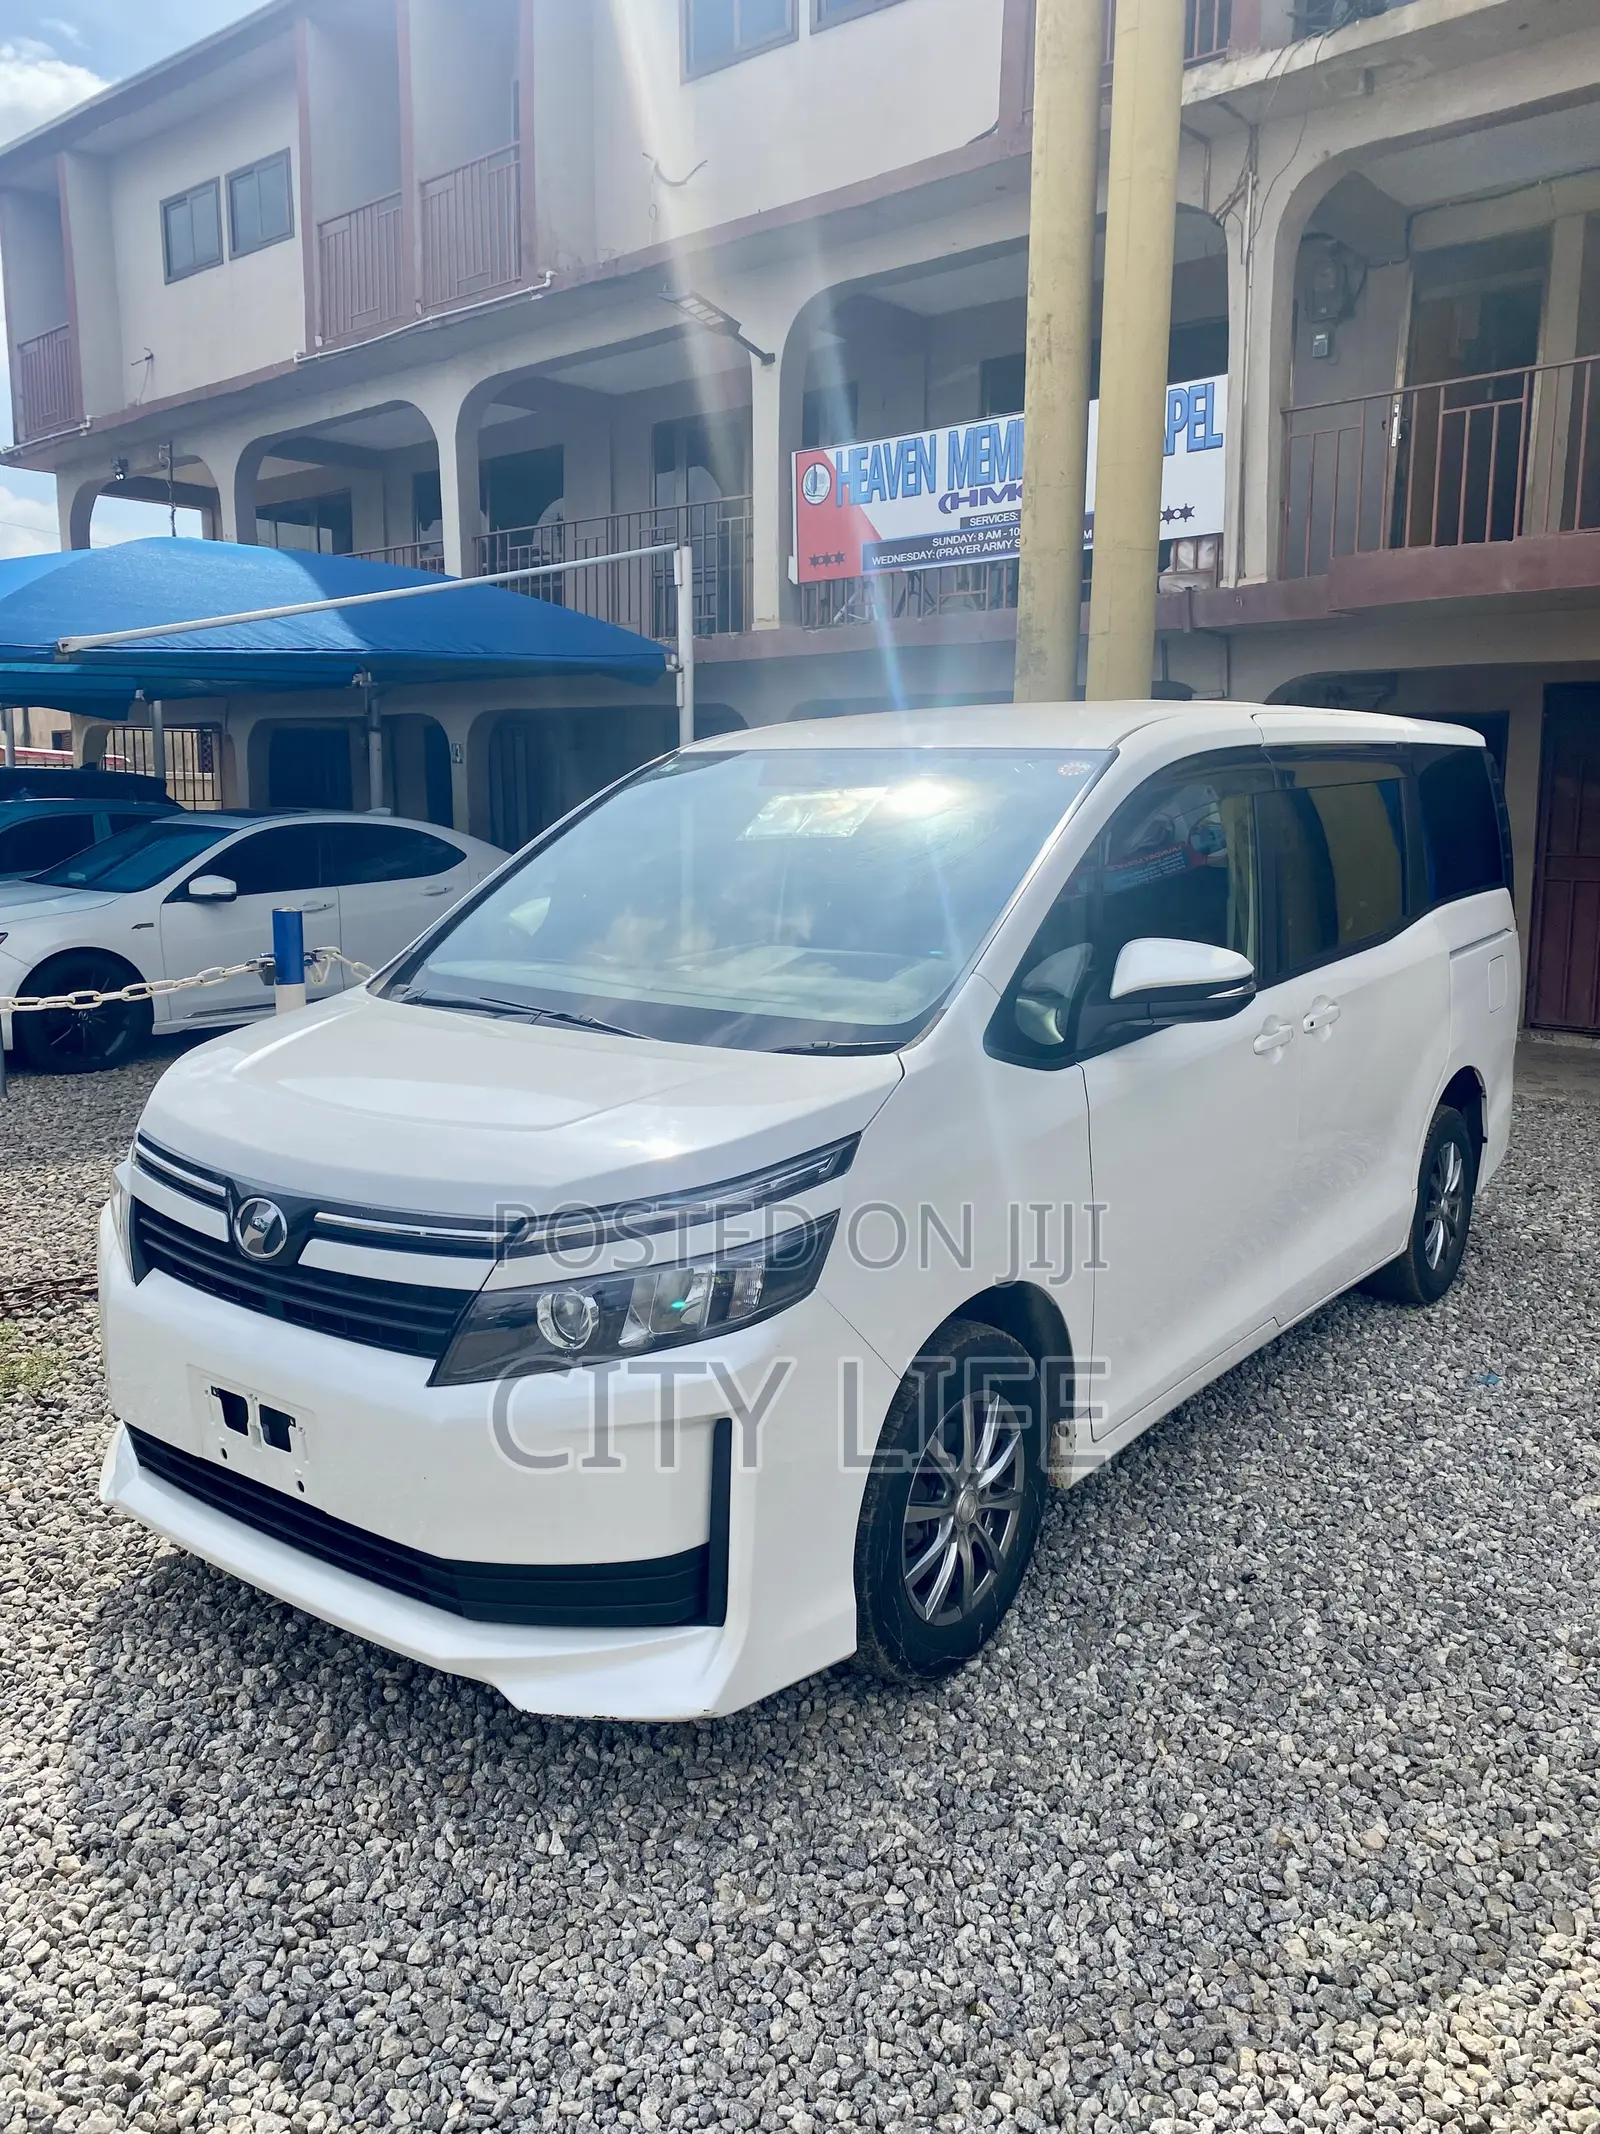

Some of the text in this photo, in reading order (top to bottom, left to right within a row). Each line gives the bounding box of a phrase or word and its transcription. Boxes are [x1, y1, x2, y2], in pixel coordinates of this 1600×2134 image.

[836, 382, 1223, 508] HEAVEN MEM PEL
[969, 511, 1018, 527] SERVICES:
[932, 532, 977, 547] SUNDAY:
[978, 532, 984, 541] 8
[985, 529, 1002, 541] AM
[872, 550, 936, 566] WEDNESDAY:
[936, 543, 981, 560] (PRAYER
[982, 540, 1013, 552] ARMY
